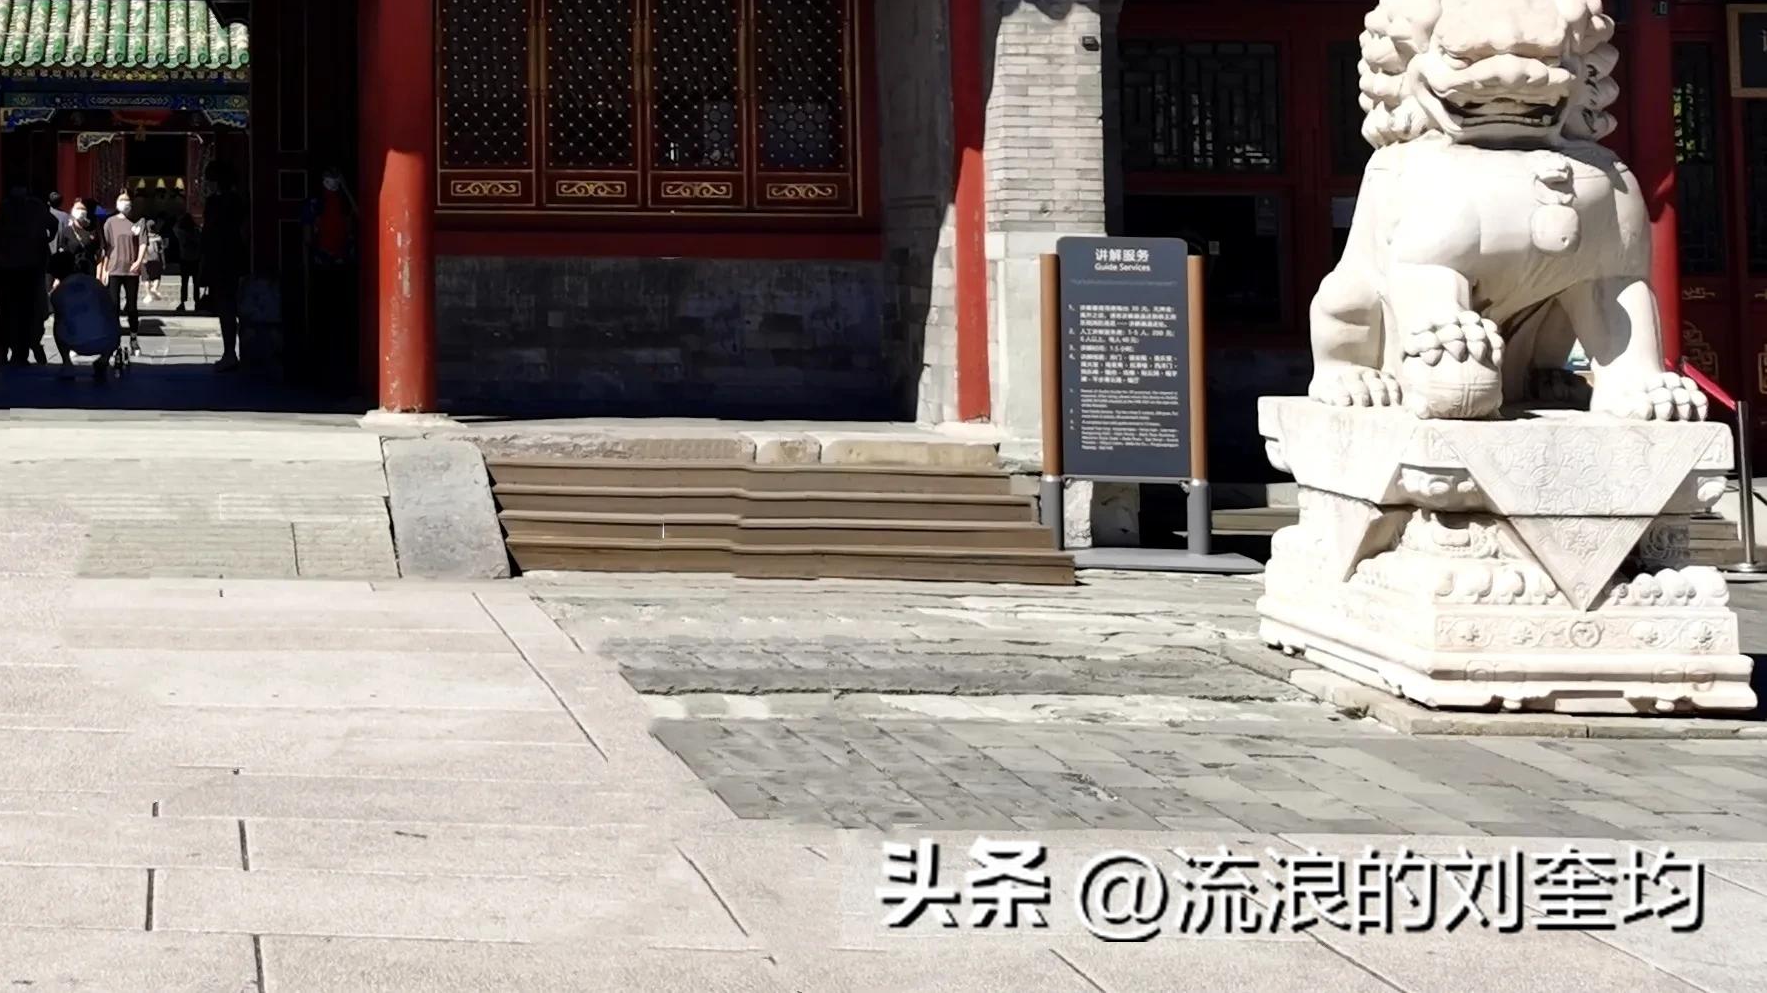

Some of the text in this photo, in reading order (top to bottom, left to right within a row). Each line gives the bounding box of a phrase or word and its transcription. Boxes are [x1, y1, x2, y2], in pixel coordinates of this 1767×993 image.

[1095, 248, 1150, 262] 讲解服务
[1094, 263, 1151, 272] Guide Services
